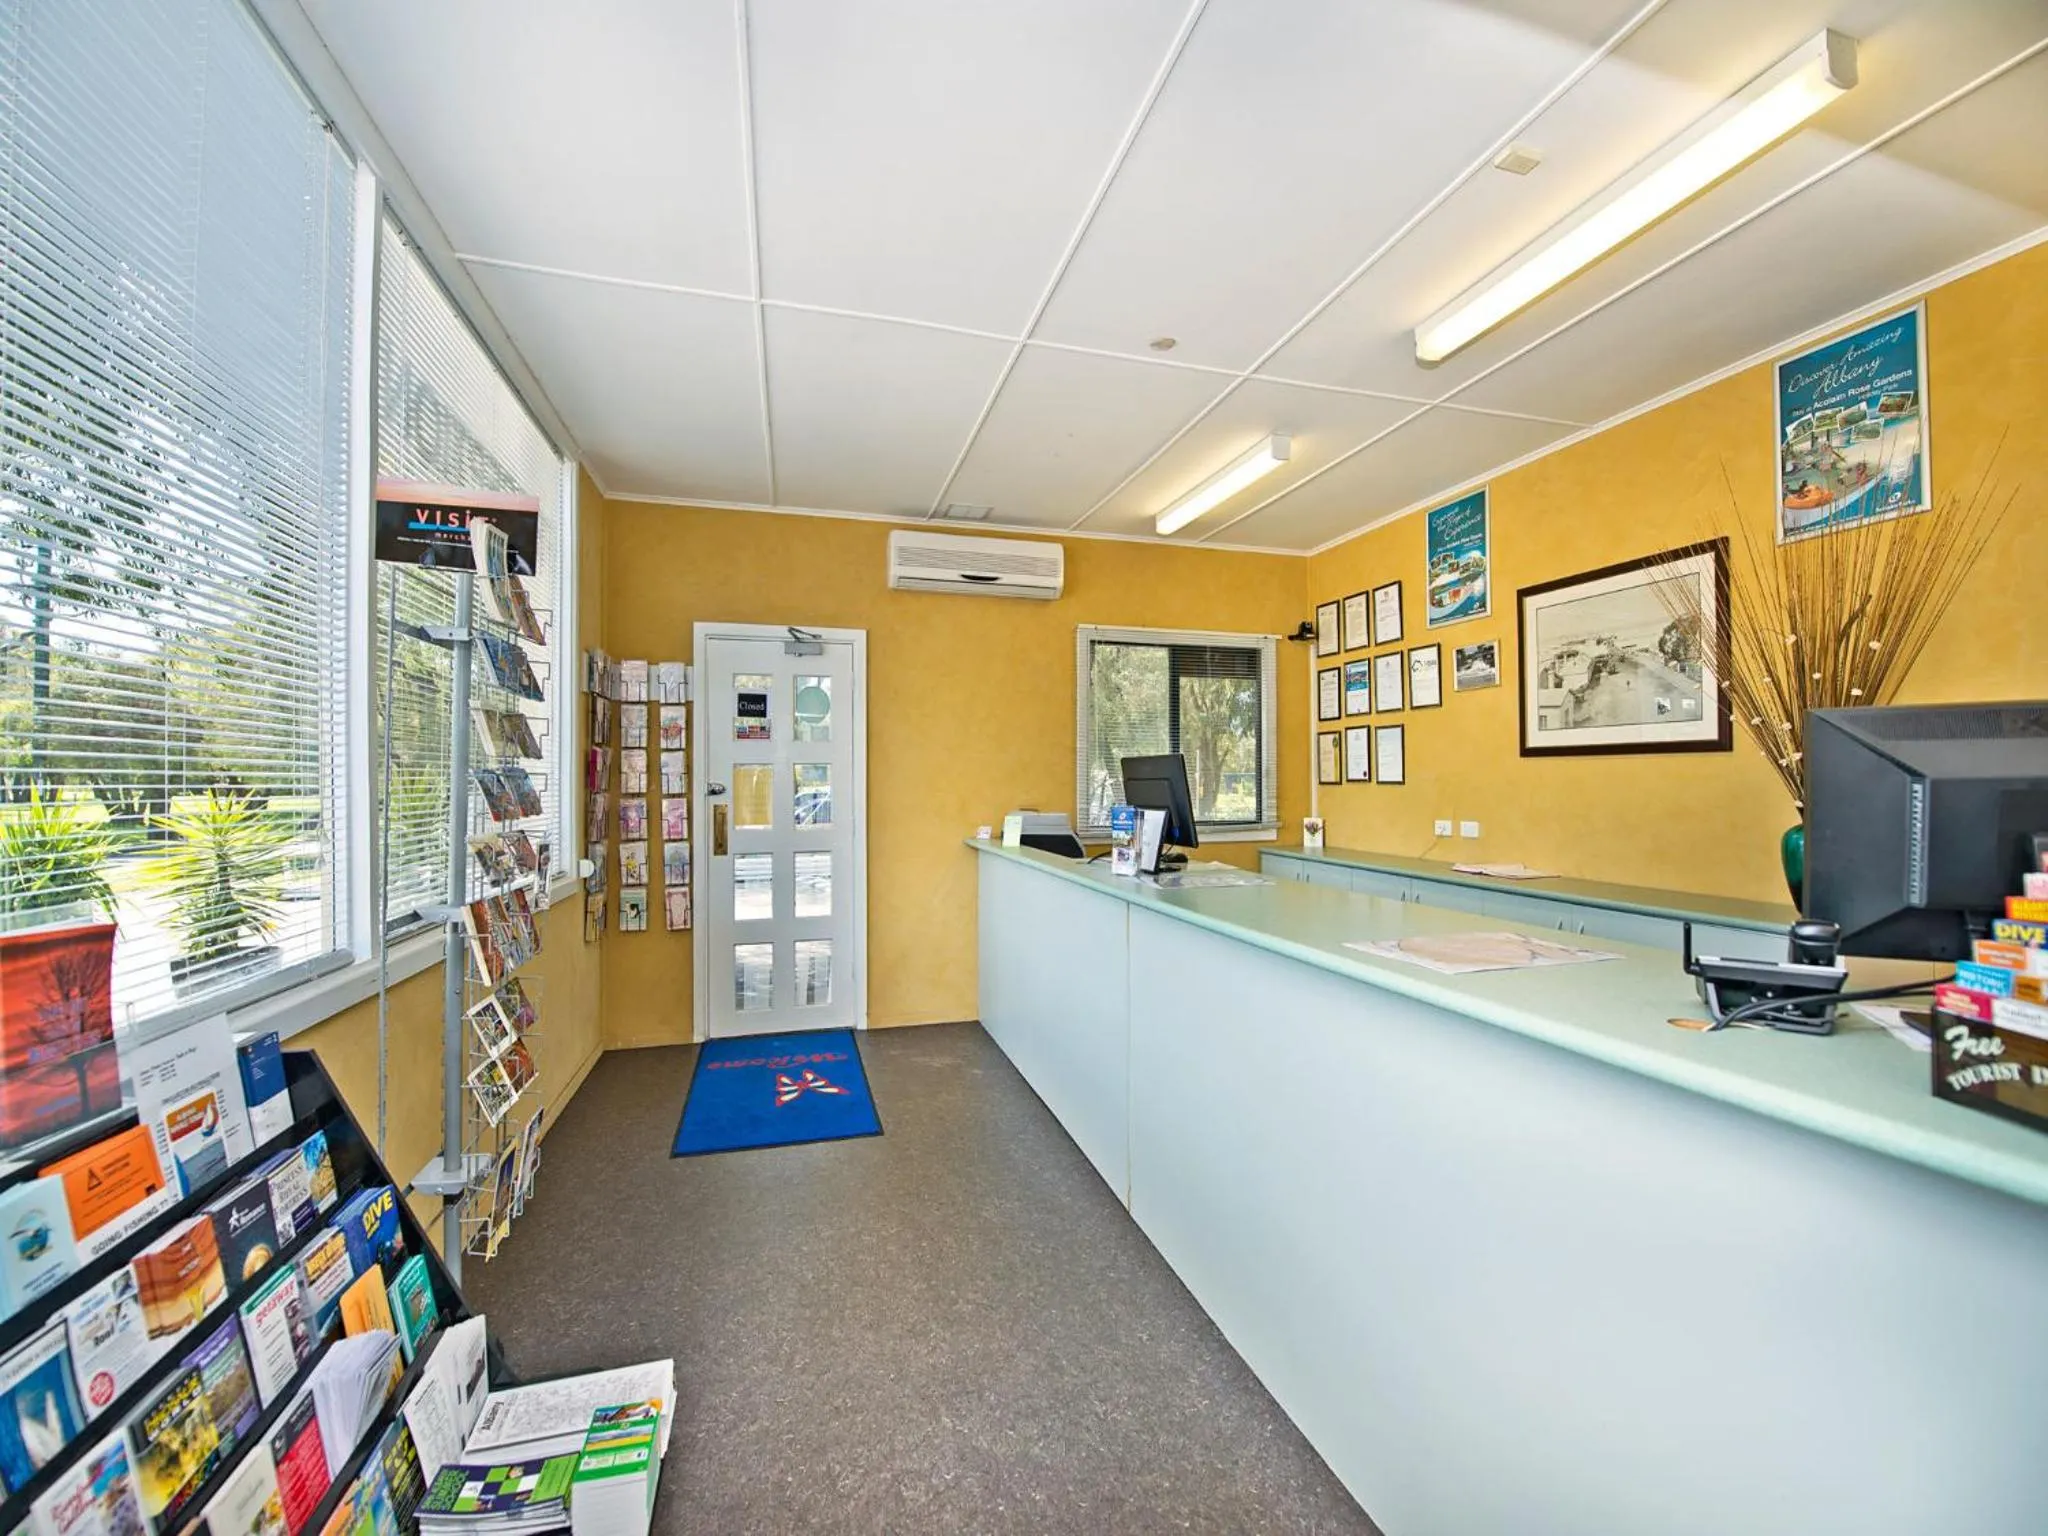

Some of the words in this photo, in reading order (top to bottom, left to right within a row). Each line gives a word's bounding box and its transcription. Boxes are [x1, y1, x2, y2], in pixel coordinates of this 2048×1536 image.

[1788, 363, 1836, 393] Discover
[1839, 327, 1904, 366] Amazing
[1812, 356, 1883, 399] Albany
[1849, 383, 1871, 397] Rose
[1872, 369, 1913, 388] Gardens
[1944, 1024, 2006, 1061] Free
[1945, 1062, 2021, 1092] TOURIST
[362, 1189, 394, 1229] DIVE
[91, 1230, 123, 1256] GOING
[124, 1206, 160, 1234] FISHING
